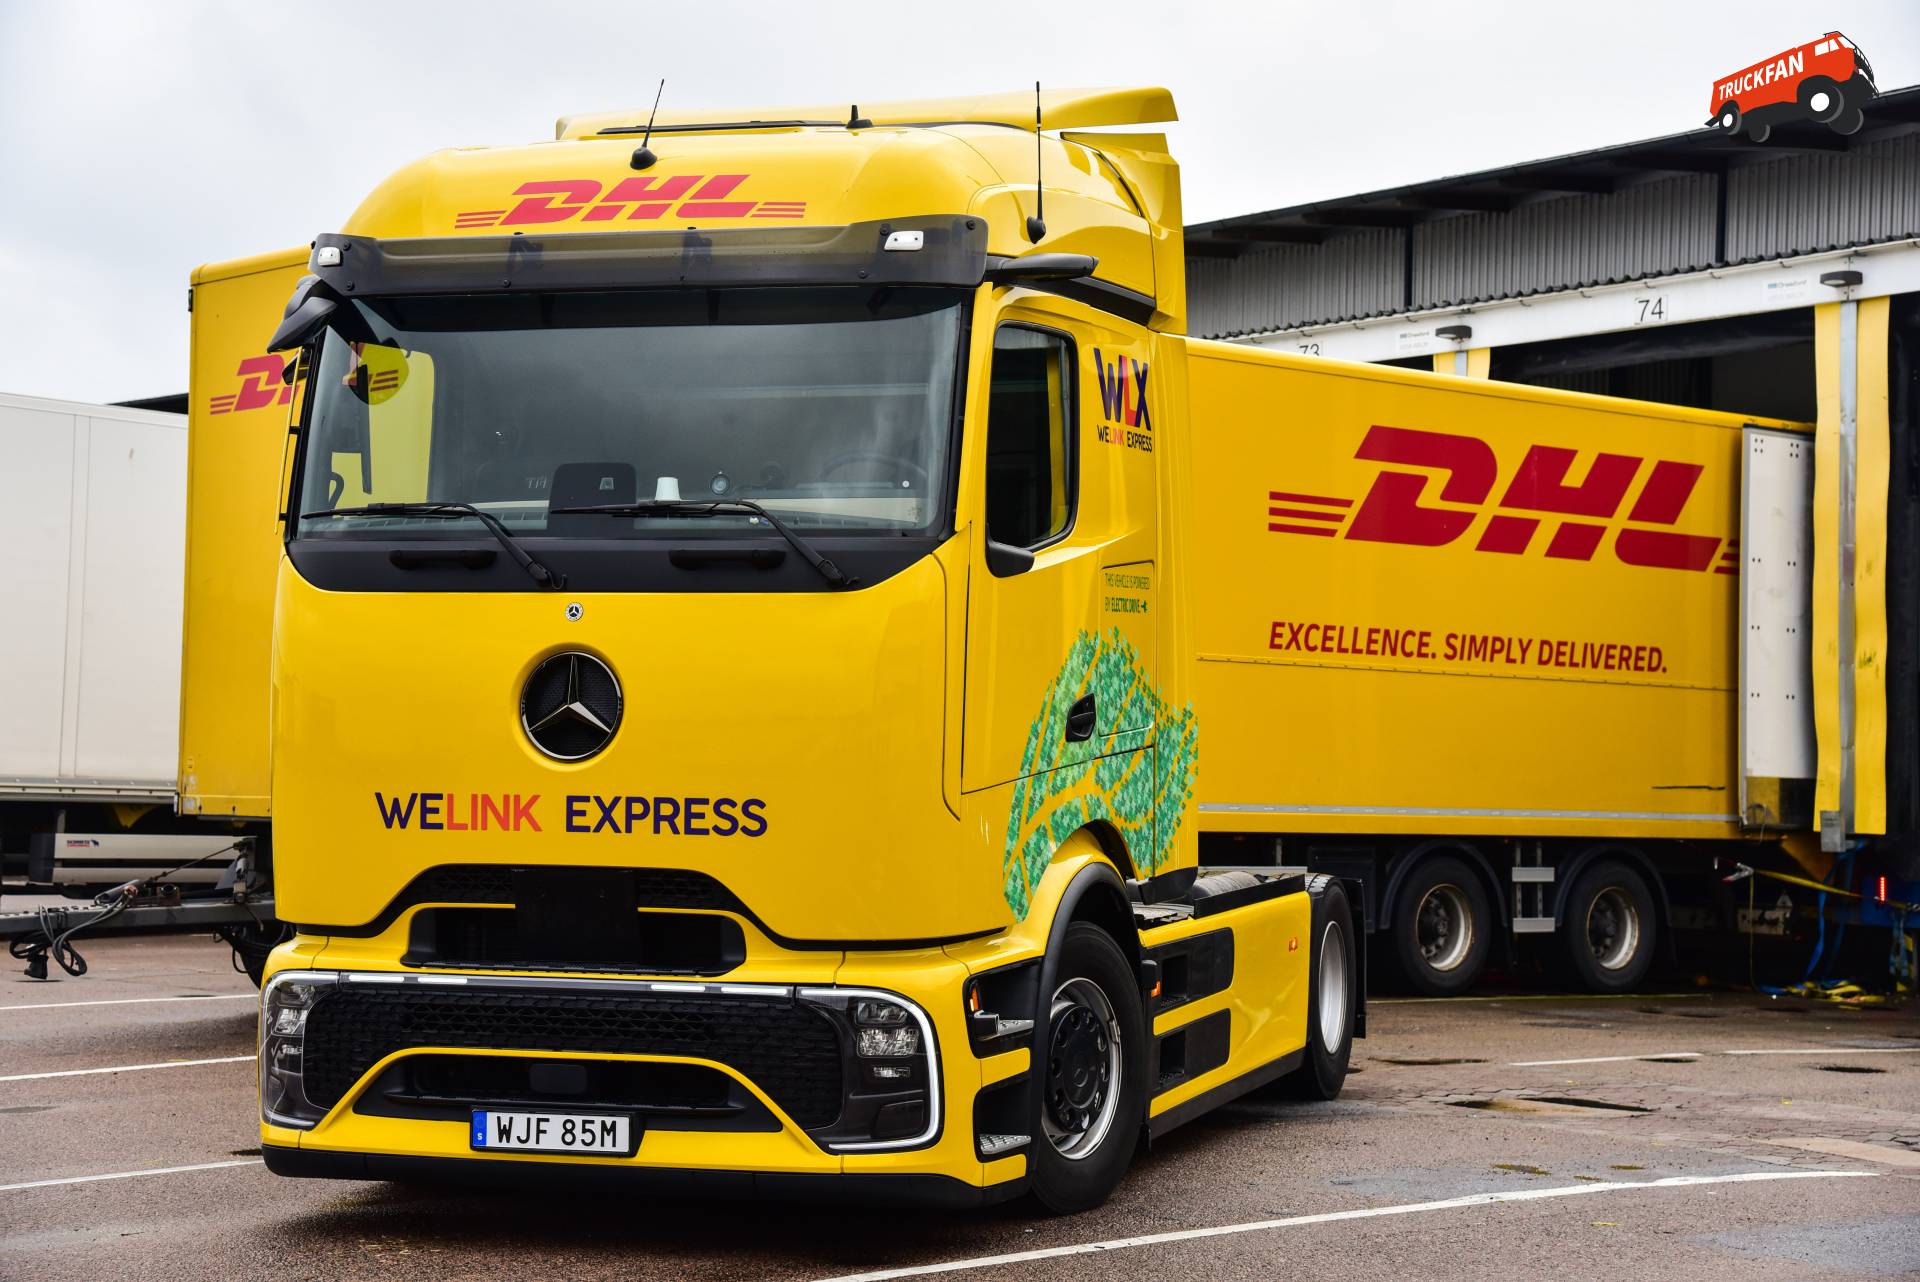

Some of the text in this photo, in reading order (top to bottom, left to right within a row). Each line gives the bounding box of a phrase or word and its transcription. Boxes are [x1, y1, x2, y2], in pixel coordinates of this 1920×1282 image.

[499, 174, 760, 226] DHL
[1638, 297, 1664, 322] 74
[1093, 347, 1152, 431] WLX
[1097, 424, 1153, 453] WELINK EXPRESS
[1344, 425, 1722, 572] DHL
[1269, 621, 1668, 673] EXCELLENCE. SIMPLY DELIVERED.
[374, 792, 768, 837] WELINK EXPRESS
[477, 1115, 617, 1148] S WJF 85M
